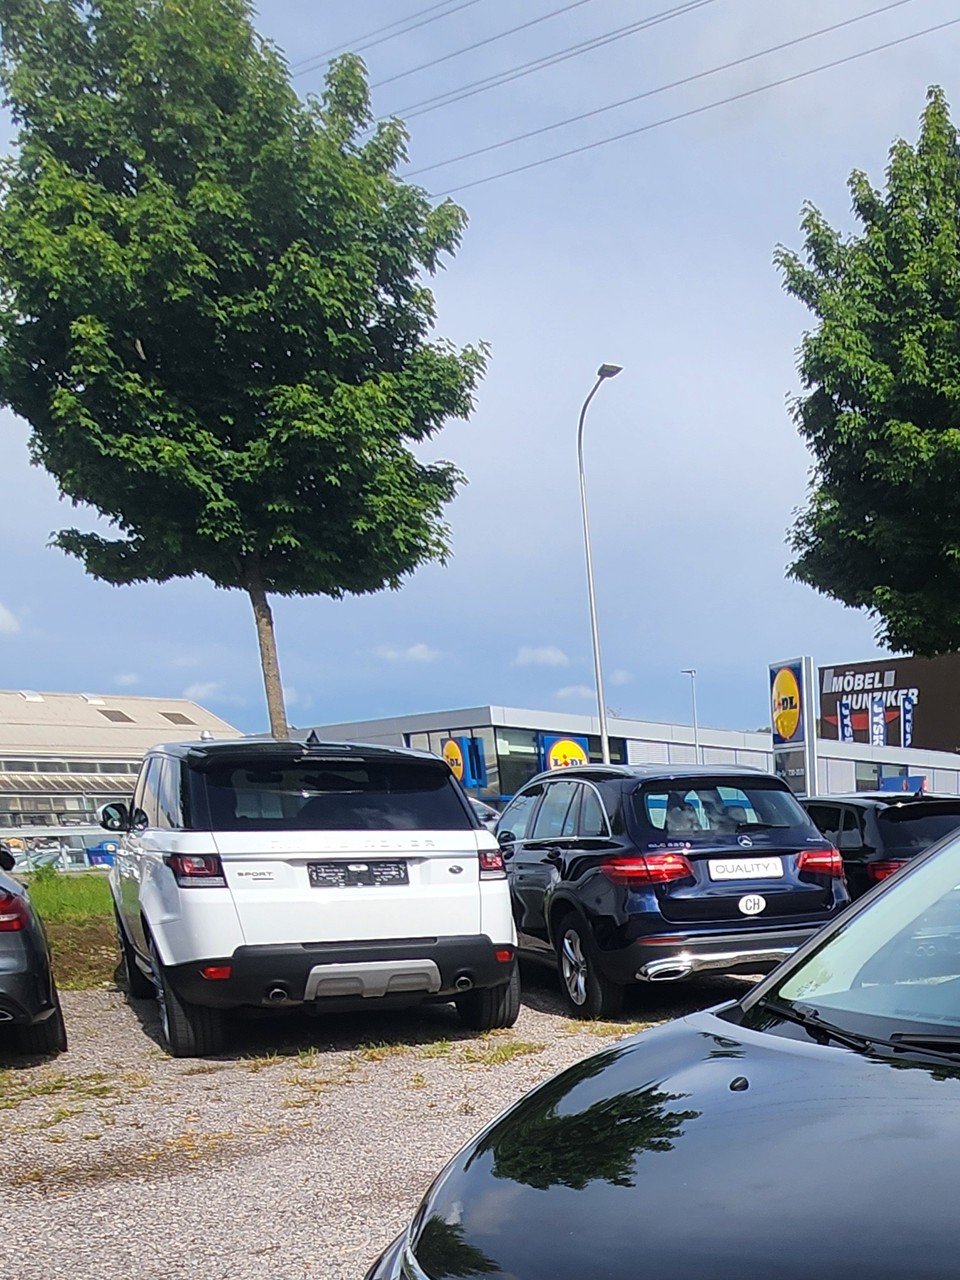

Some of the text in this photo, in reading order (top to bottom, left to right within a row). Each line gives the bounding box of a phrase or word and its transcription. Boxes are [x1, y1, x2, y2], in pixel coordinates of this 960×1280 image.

[831, 671, 883, 693] MÖBEL
[872, 704, 884, 747] JYSK
[715, 862, 770, 874] QUALITY
[745, 899, 760, 911] CH
